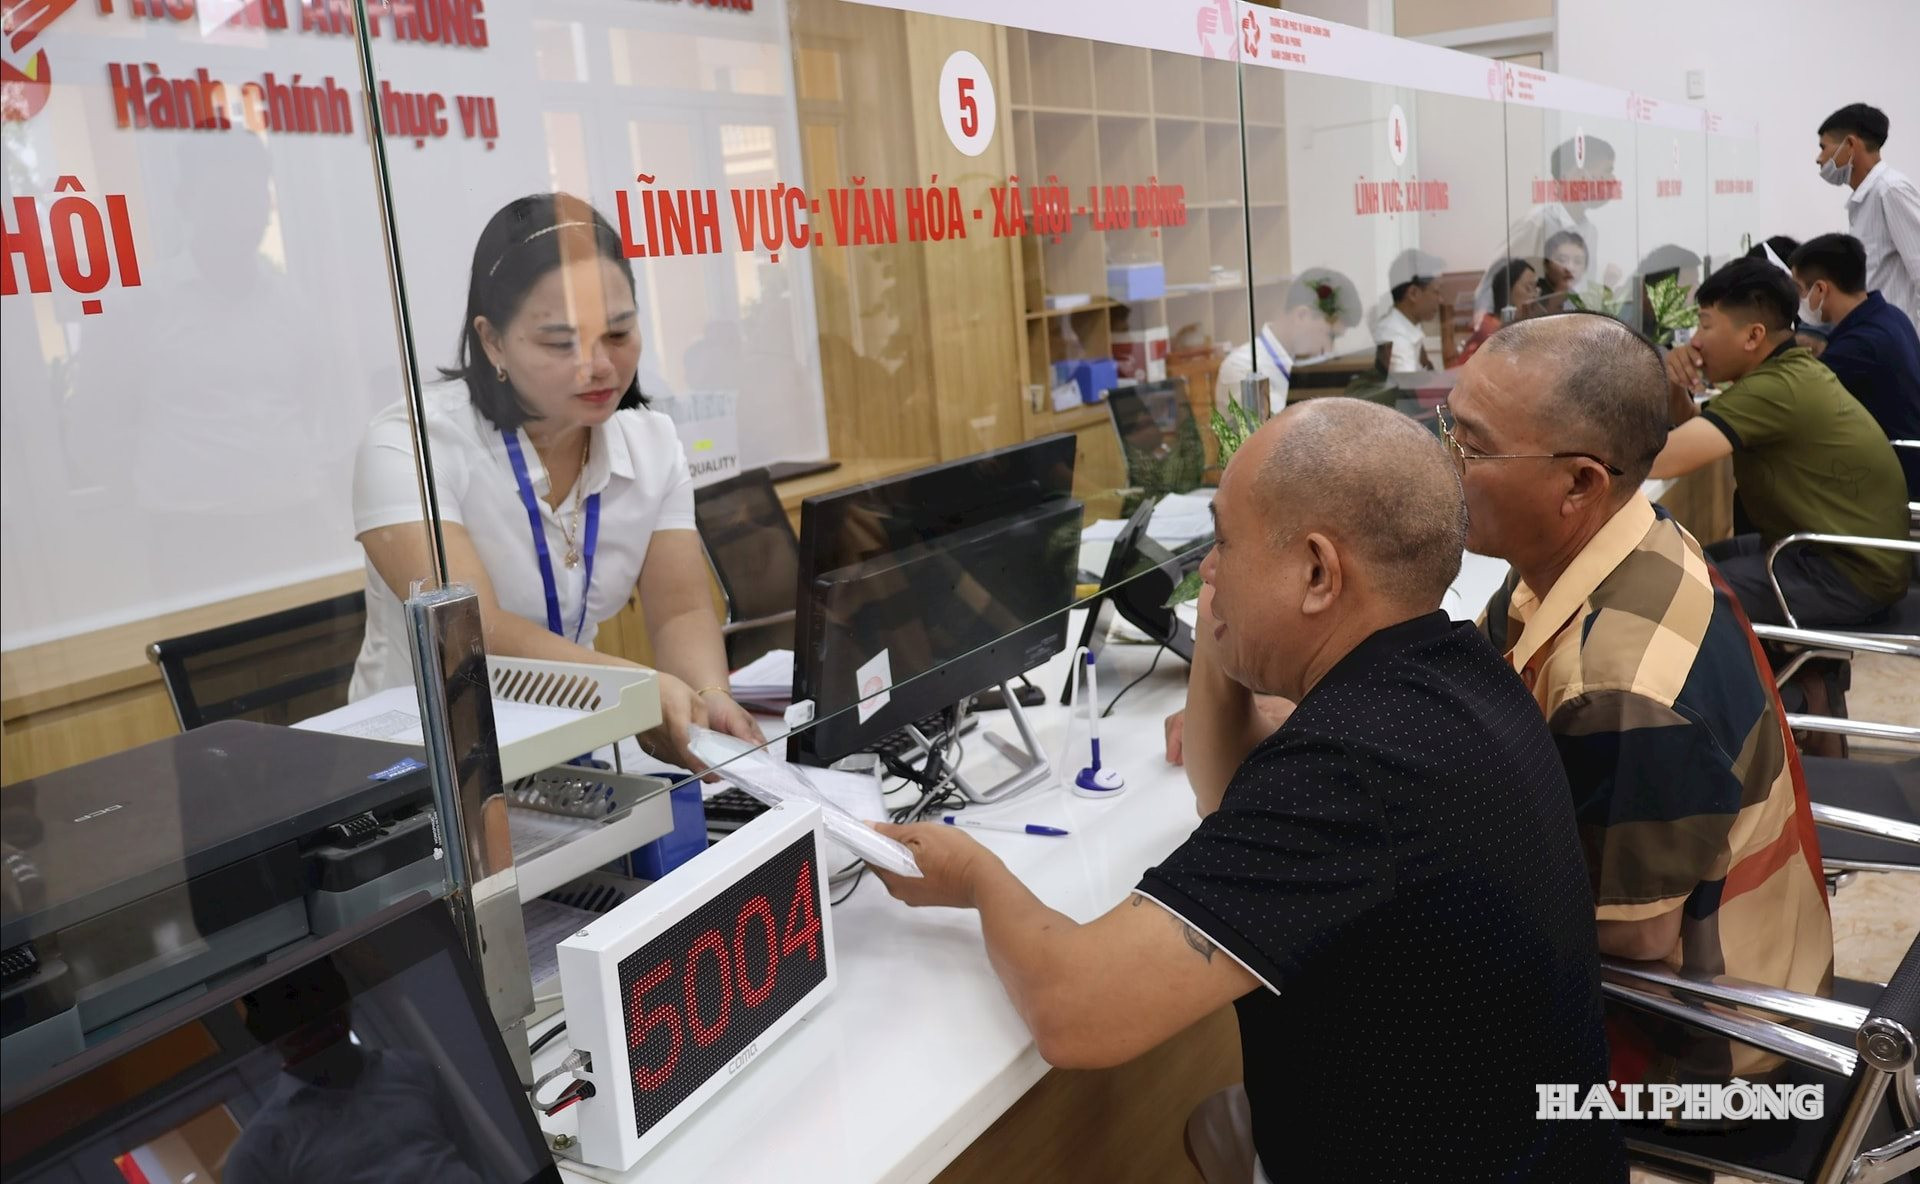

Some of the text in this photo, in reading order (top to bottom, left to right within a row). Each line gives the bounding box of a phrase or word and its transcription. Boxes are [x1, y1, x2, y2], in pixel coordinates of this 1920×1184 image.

[108, 62, 499, 150] Hành chính hục vụ
[958, 77, 979, 138] 5
[1394, 117, 1402, 153] 4
[615, 173, 723, 259] LĨNH
[730, 182, 824, 264] VỰC:
[827, 175, 898, 247] VĂN
[905, 174, 967, 242] HÓA
[990, 175, 1027, 238] XÃ
[1032, 175, 1072, 244] HỘI
[1090, 184, 1131, 231] LAO
[1134, 175, 1186, 238] ĐỘNG
[1355, 175, 1380, 216] LĨNH
[0, 175, 142, 315] HỘI
[629, 859, 822, 1092] 5004
